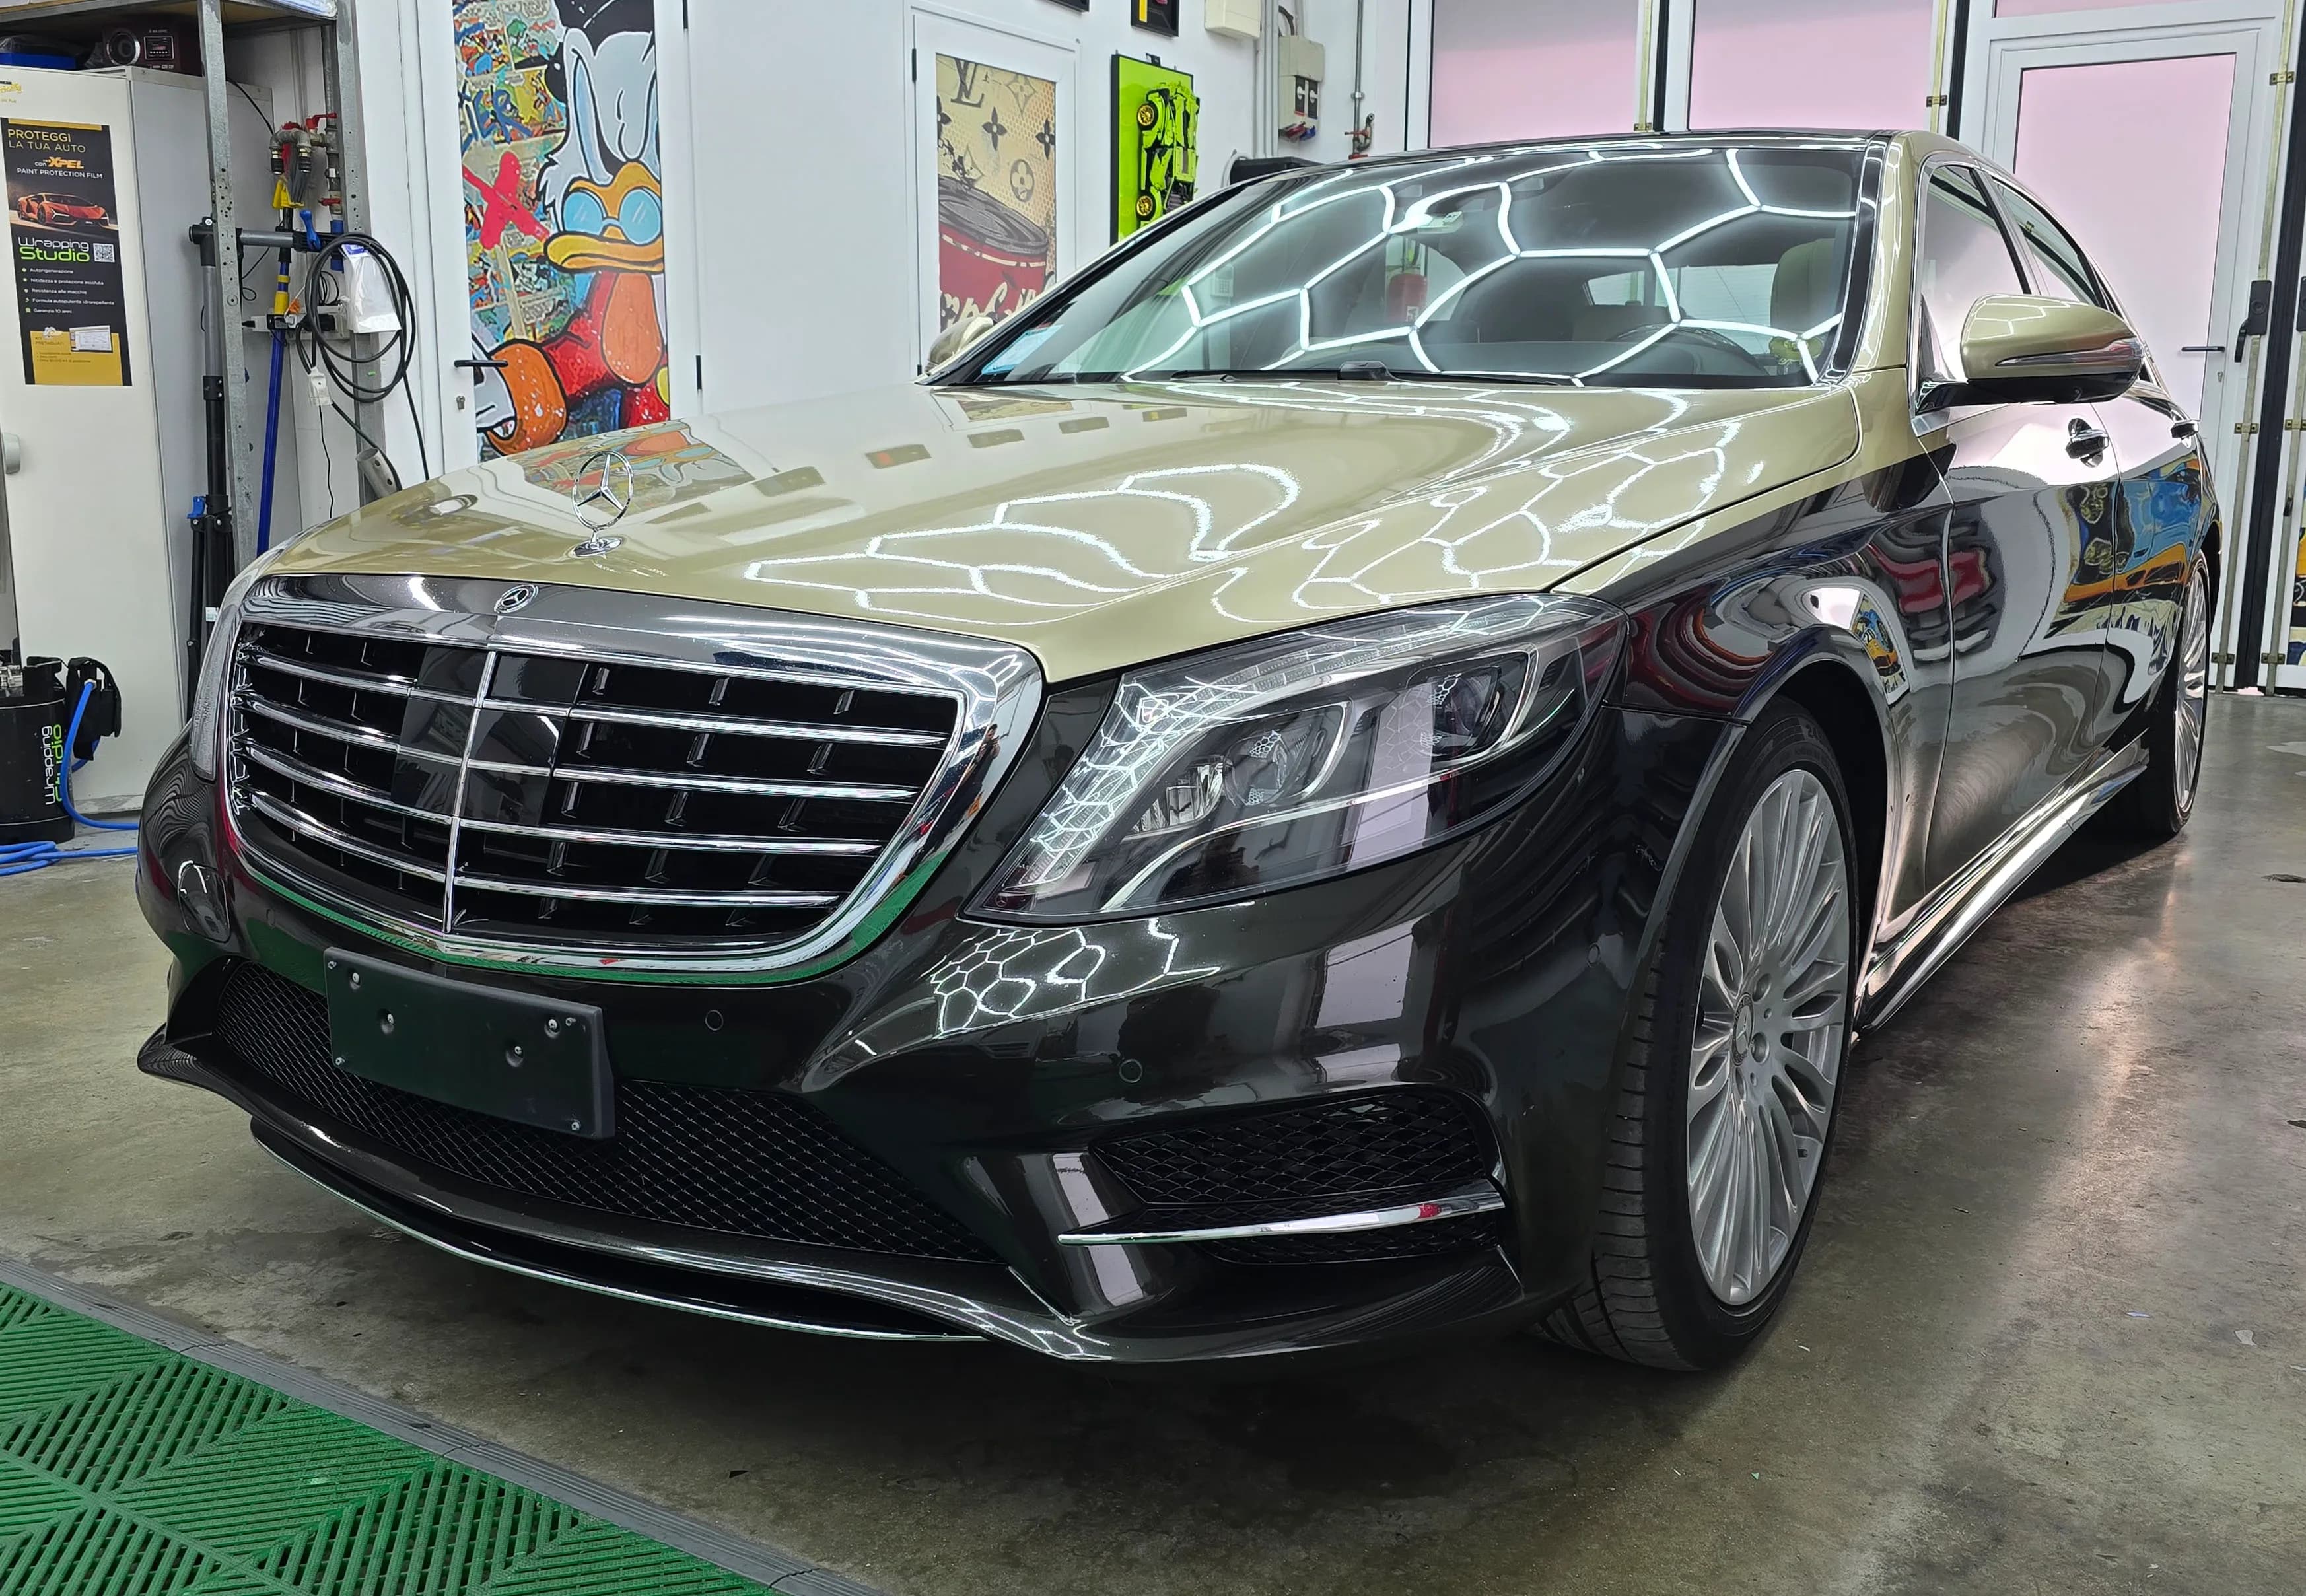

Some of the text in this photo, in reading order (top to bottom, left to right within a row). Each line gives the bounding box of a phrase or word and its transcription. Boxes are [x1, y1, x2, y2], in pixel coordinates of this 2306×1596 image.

[8, 129, 71, 143] PROTEGGI
[9, 140, 86, 153] LA TUA AUTO
[48, 156, 85, 170] XPEL
[40, 169, 85, 178] PROTECTION
[18, 236, 90, 252] Wrapping
[20, 246, 90, 262] Studio
[40, 726, 55, 805] Wrapping
